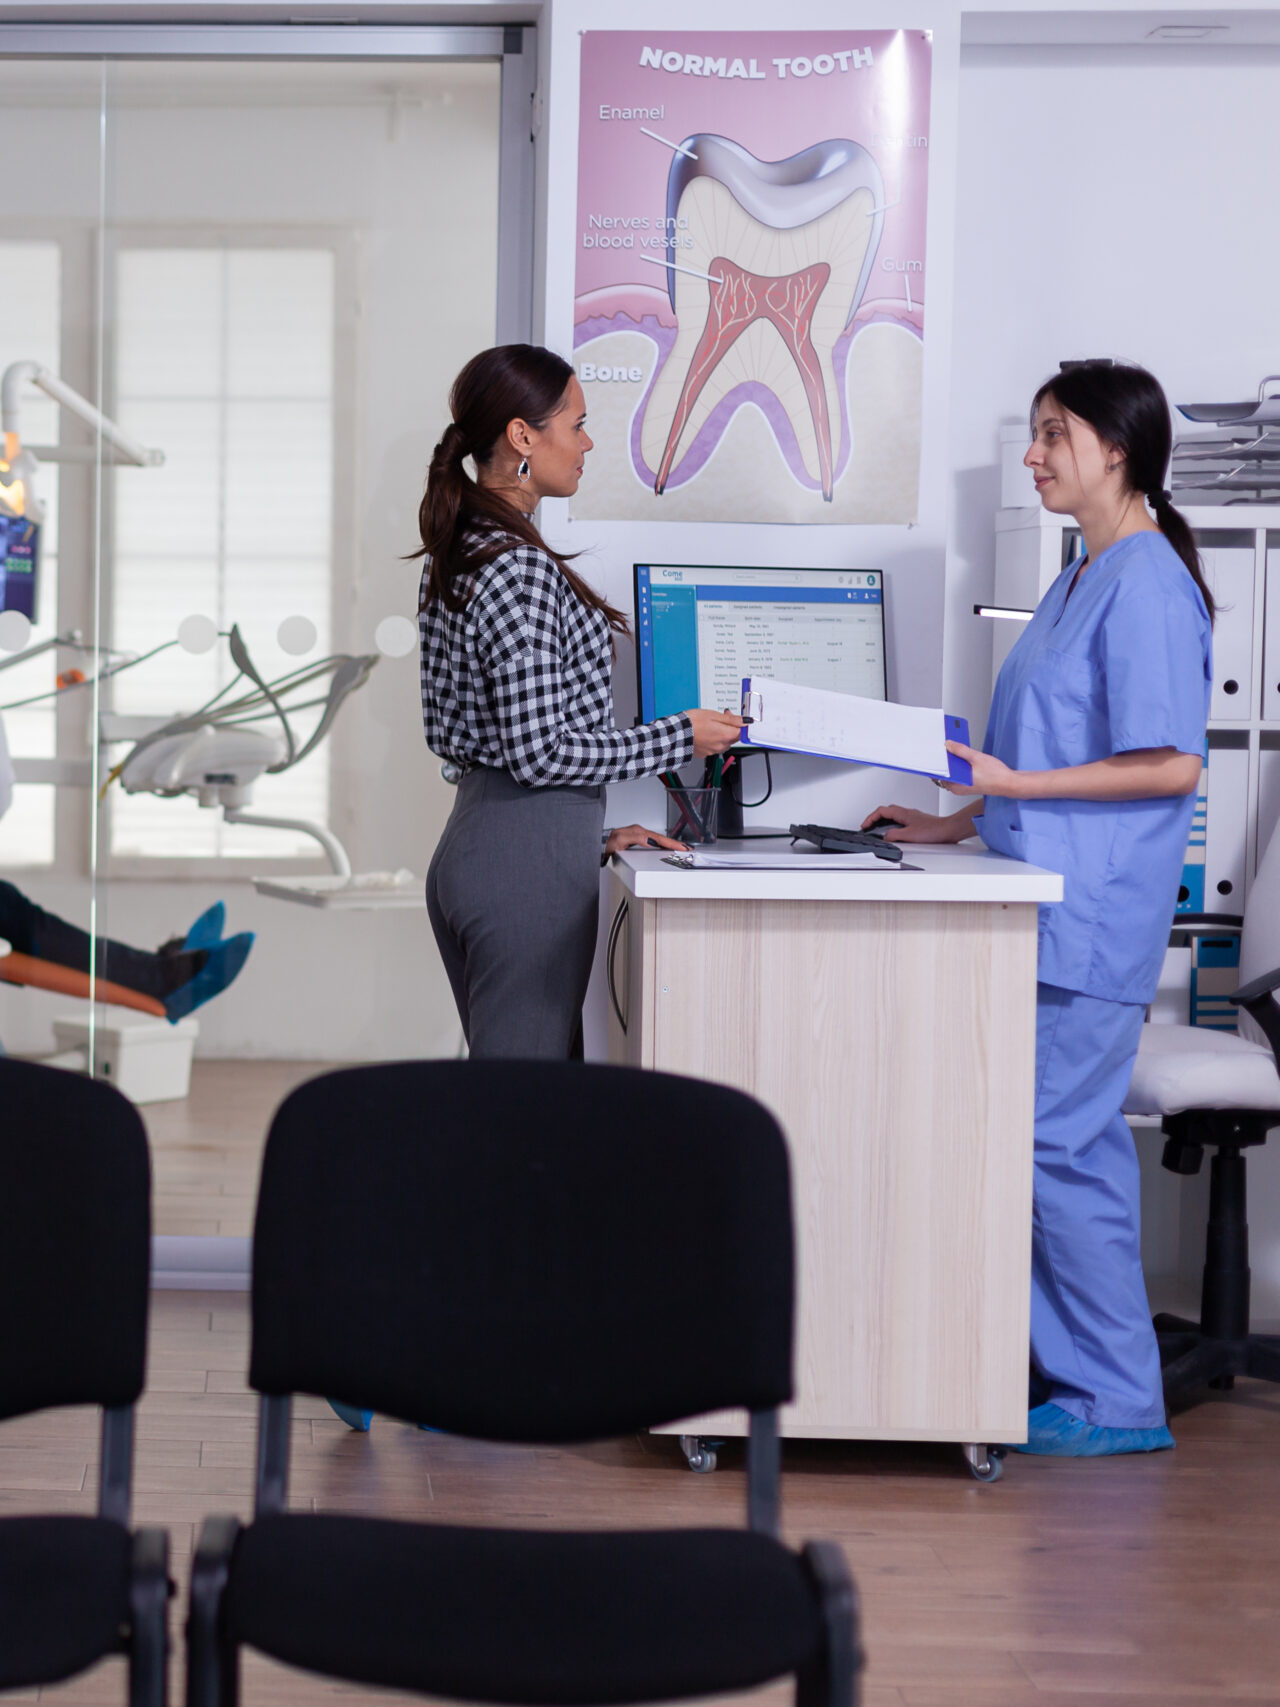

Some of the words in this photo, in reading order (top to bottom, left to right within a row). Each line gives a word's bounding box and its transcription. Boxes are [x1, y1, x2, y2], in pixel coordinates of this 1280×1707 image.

[639, 46, 766, 79] NORMAL
[773, 46, 874, 78] TOOTH
[599, 104, 665, 120] Enamel
[870, 134, 928, 148] Dtin
[588, 214, 649, 230] Nerves
[655, 214, 690, 230] and
[583, 233, 634, 249] blood
[640, 233, 694, 250] vesels
[881, 257, 923, 272] Gum
[580, 363, 643, 383] Bone
